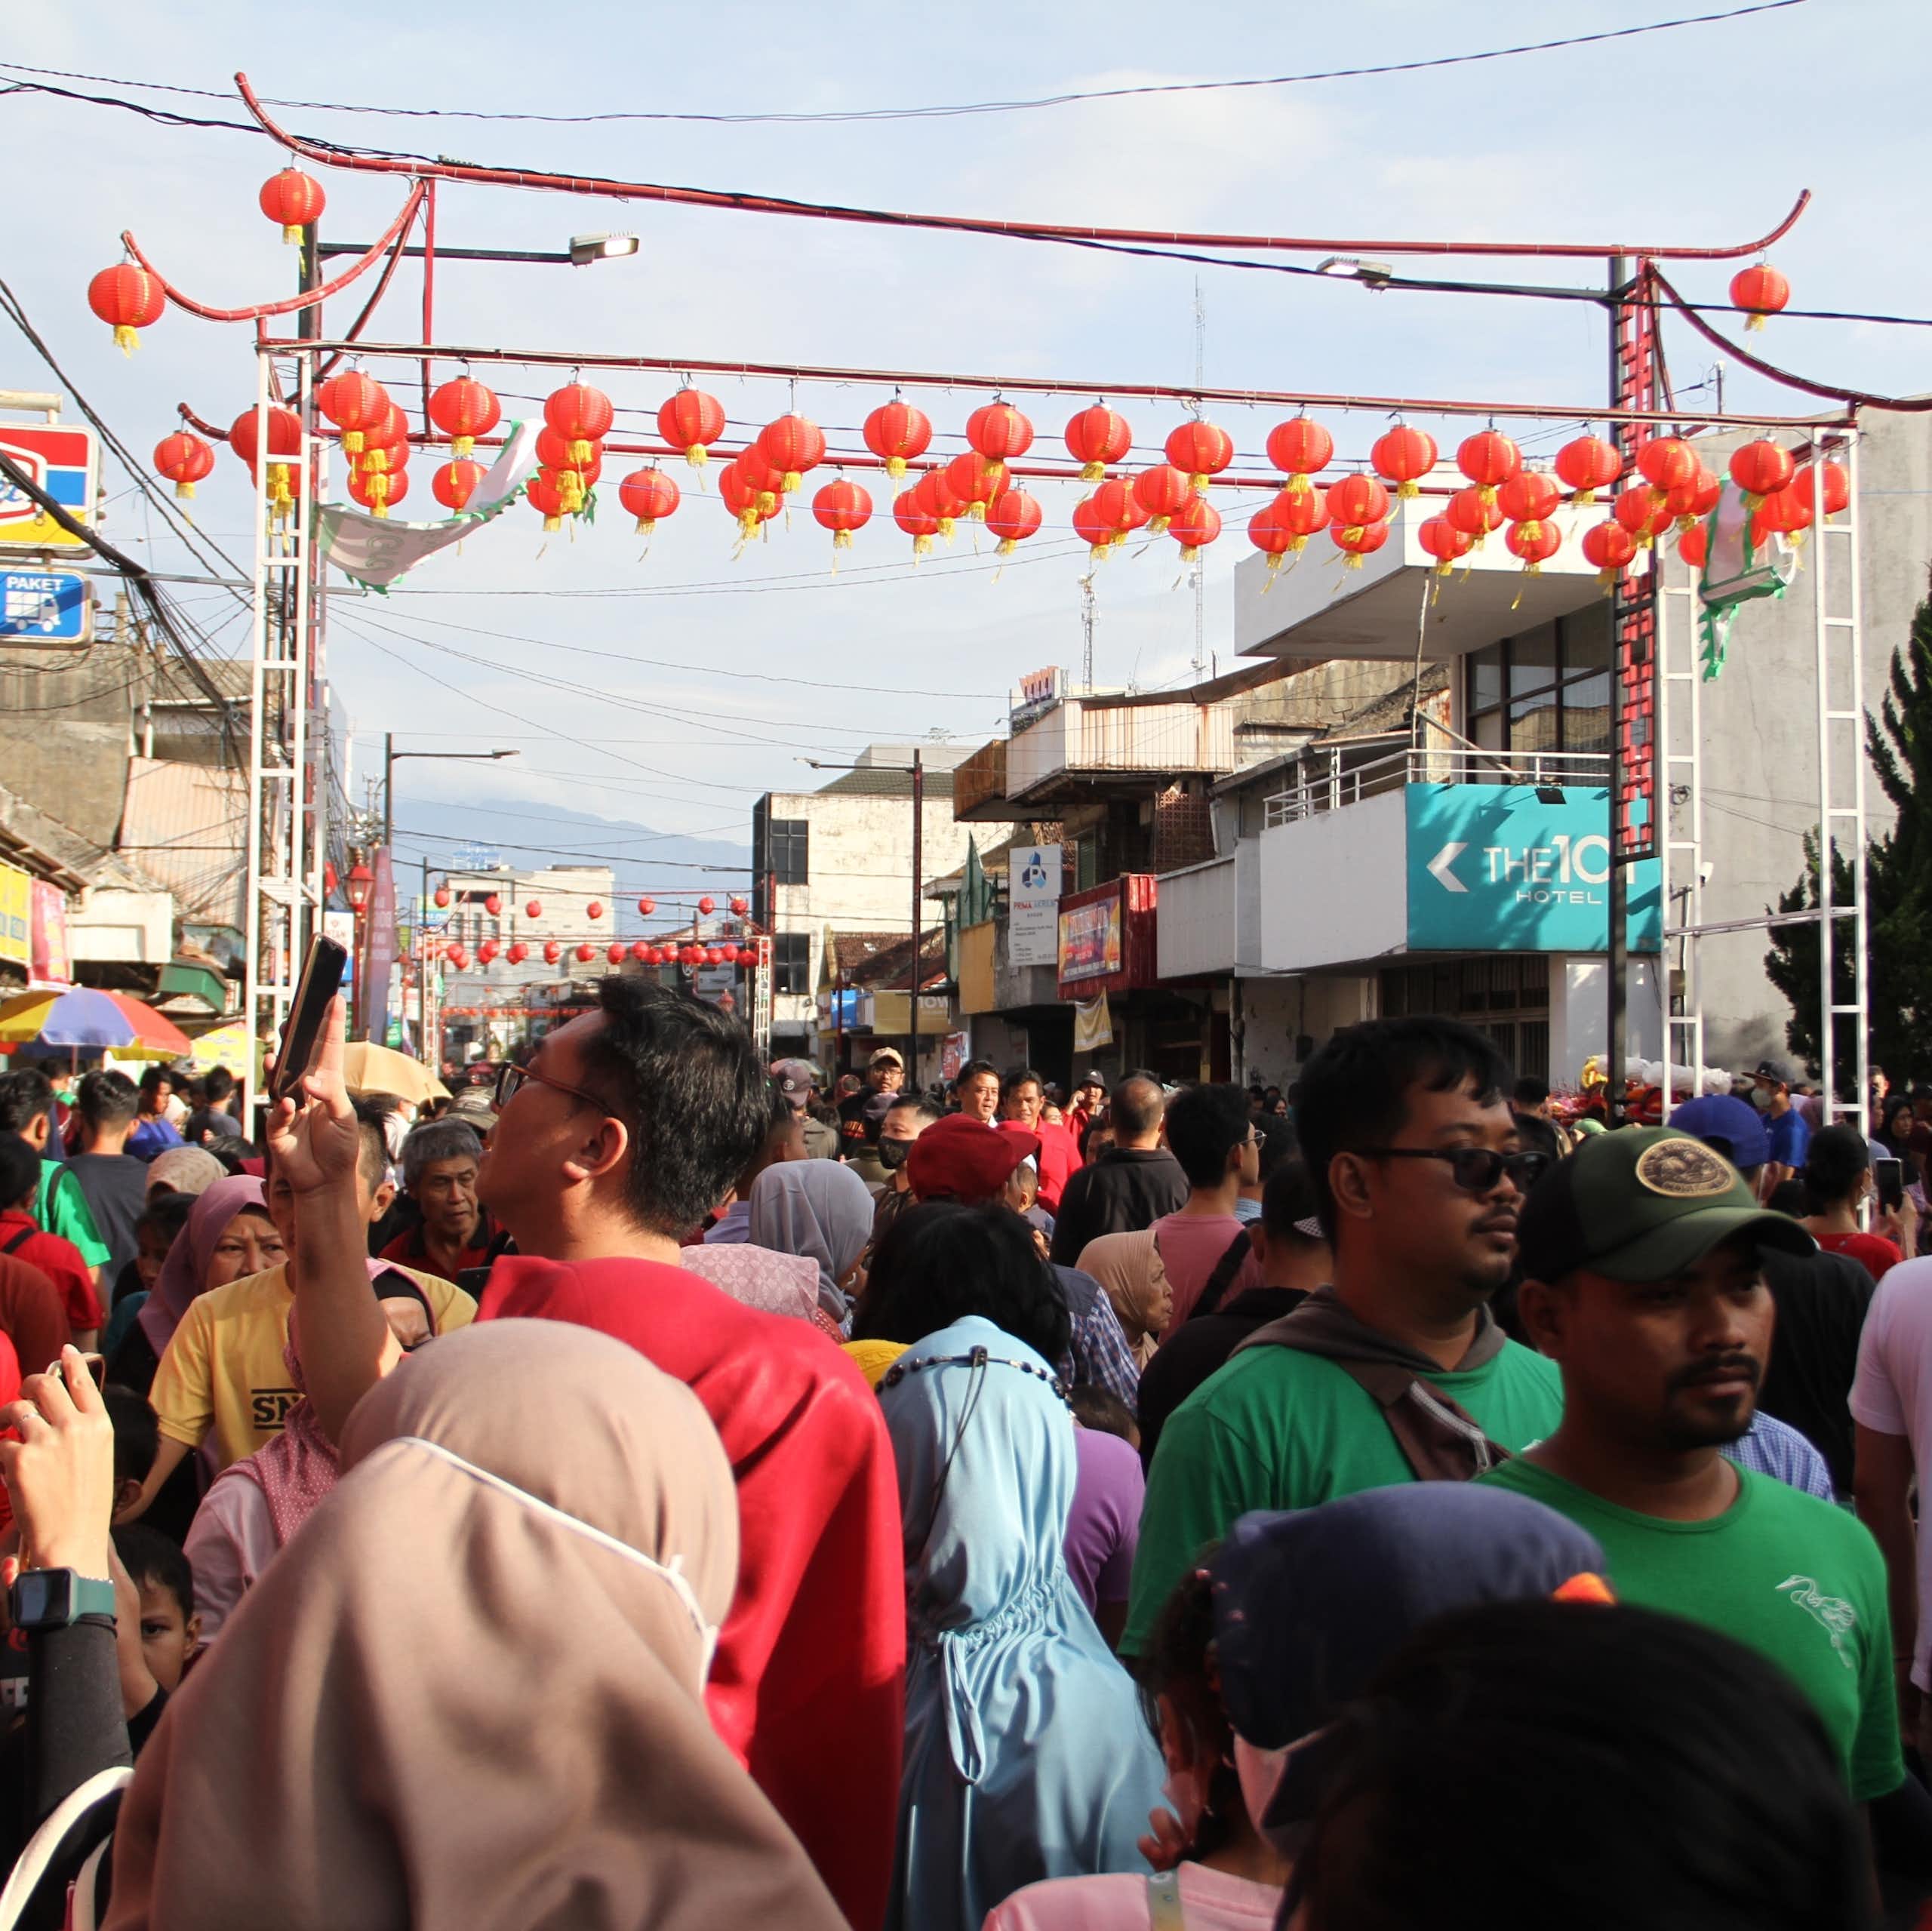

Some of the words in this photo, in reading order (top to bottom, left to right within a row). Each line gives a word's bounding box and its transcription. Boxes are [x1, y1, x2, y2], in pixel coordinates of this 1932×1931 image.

[6, 576, 64, 592] PAKET
[1483, 847, 1552, 883] THE
[1515, 890, 1602, 905] HOTEL
